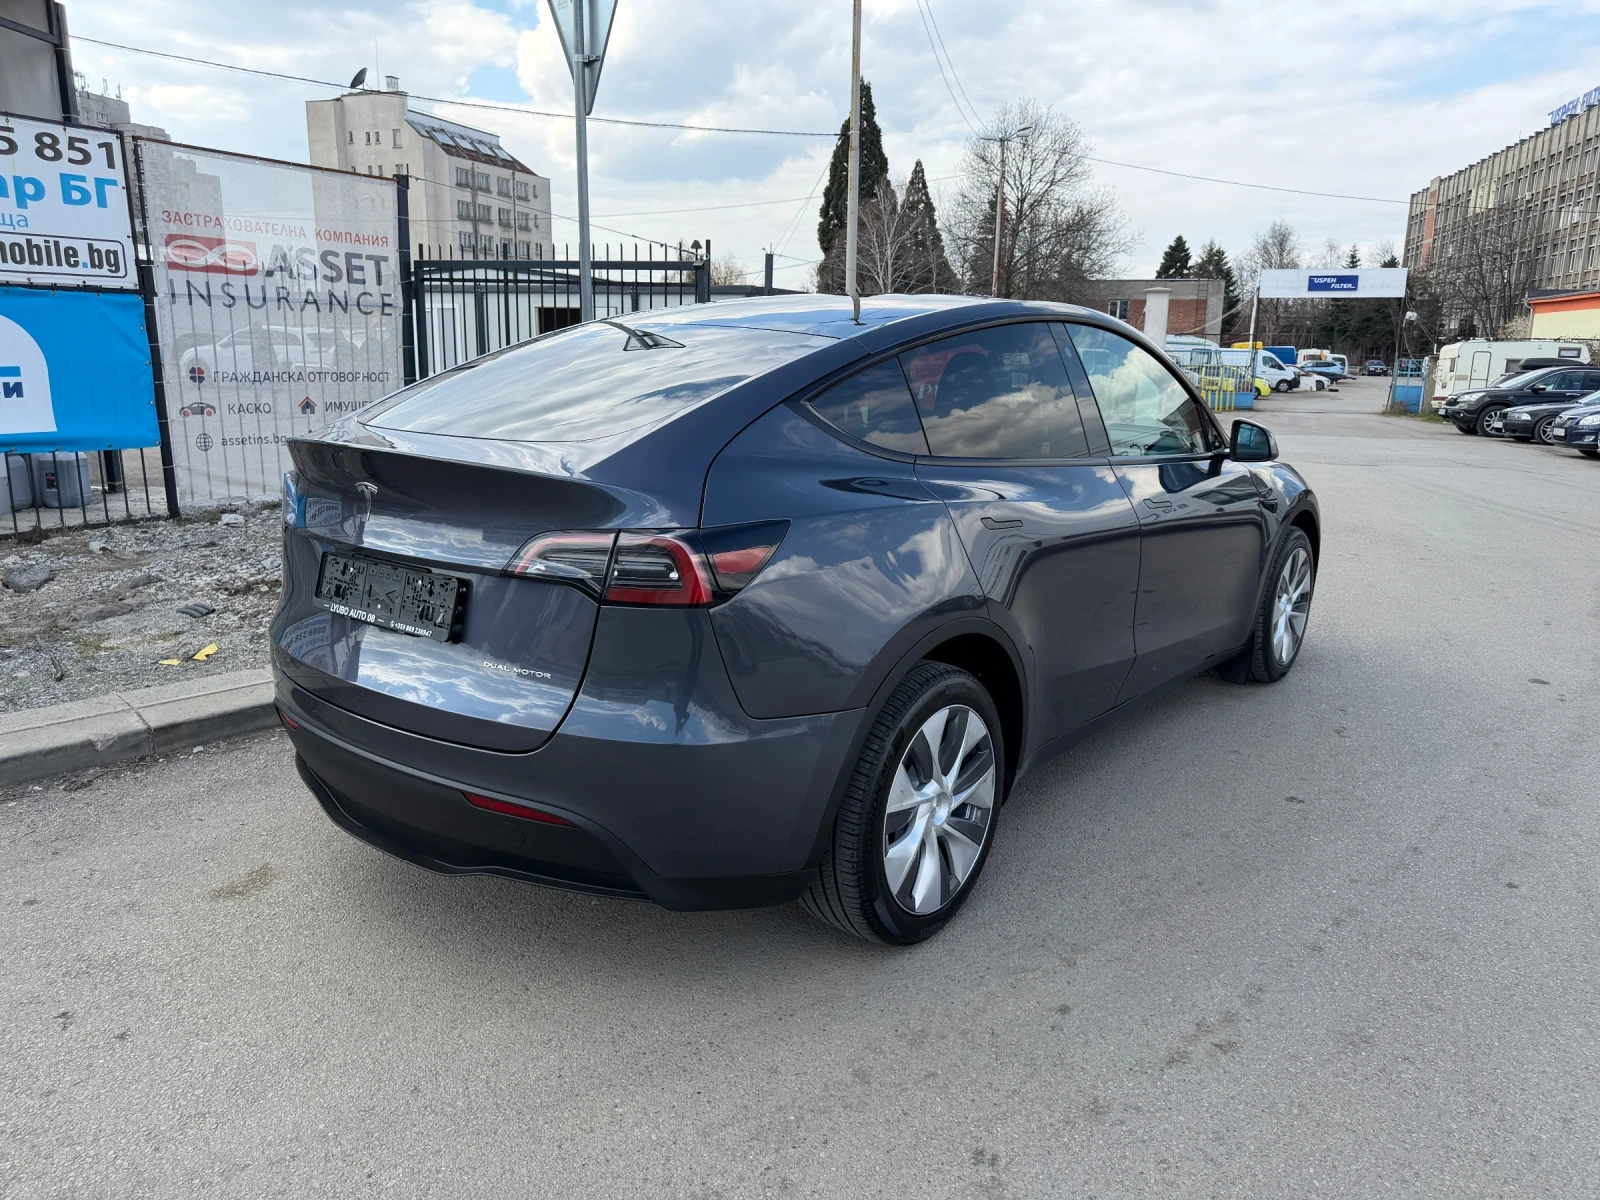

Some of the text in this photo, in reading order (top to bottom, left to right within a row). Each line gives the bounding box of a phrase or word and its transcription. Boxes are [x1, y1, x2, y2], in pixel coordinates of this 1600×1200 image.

[34, 132, 115, 169] 851
[59, 172, 118, 208] БГ
[162, 210, 388, 247] ЗАСТРАХОВАТЕЛНА КОМПАНИЯ
[264, 244, 389, 287] ASSET
[169, 278, 393, 317] INSURANCE
[214, 371, 392, 385] ГРАЖДАНСКА ОТГОВОРНОСТ
[228, 401, 373, 415] КАСКО ИМУЩЕ
[222, 432, 287, 446] assetins.bg
[330, 603, 376, 623] LYUBO AUTO 08
[483, 661, 551, 679] DUAL MOTOR
